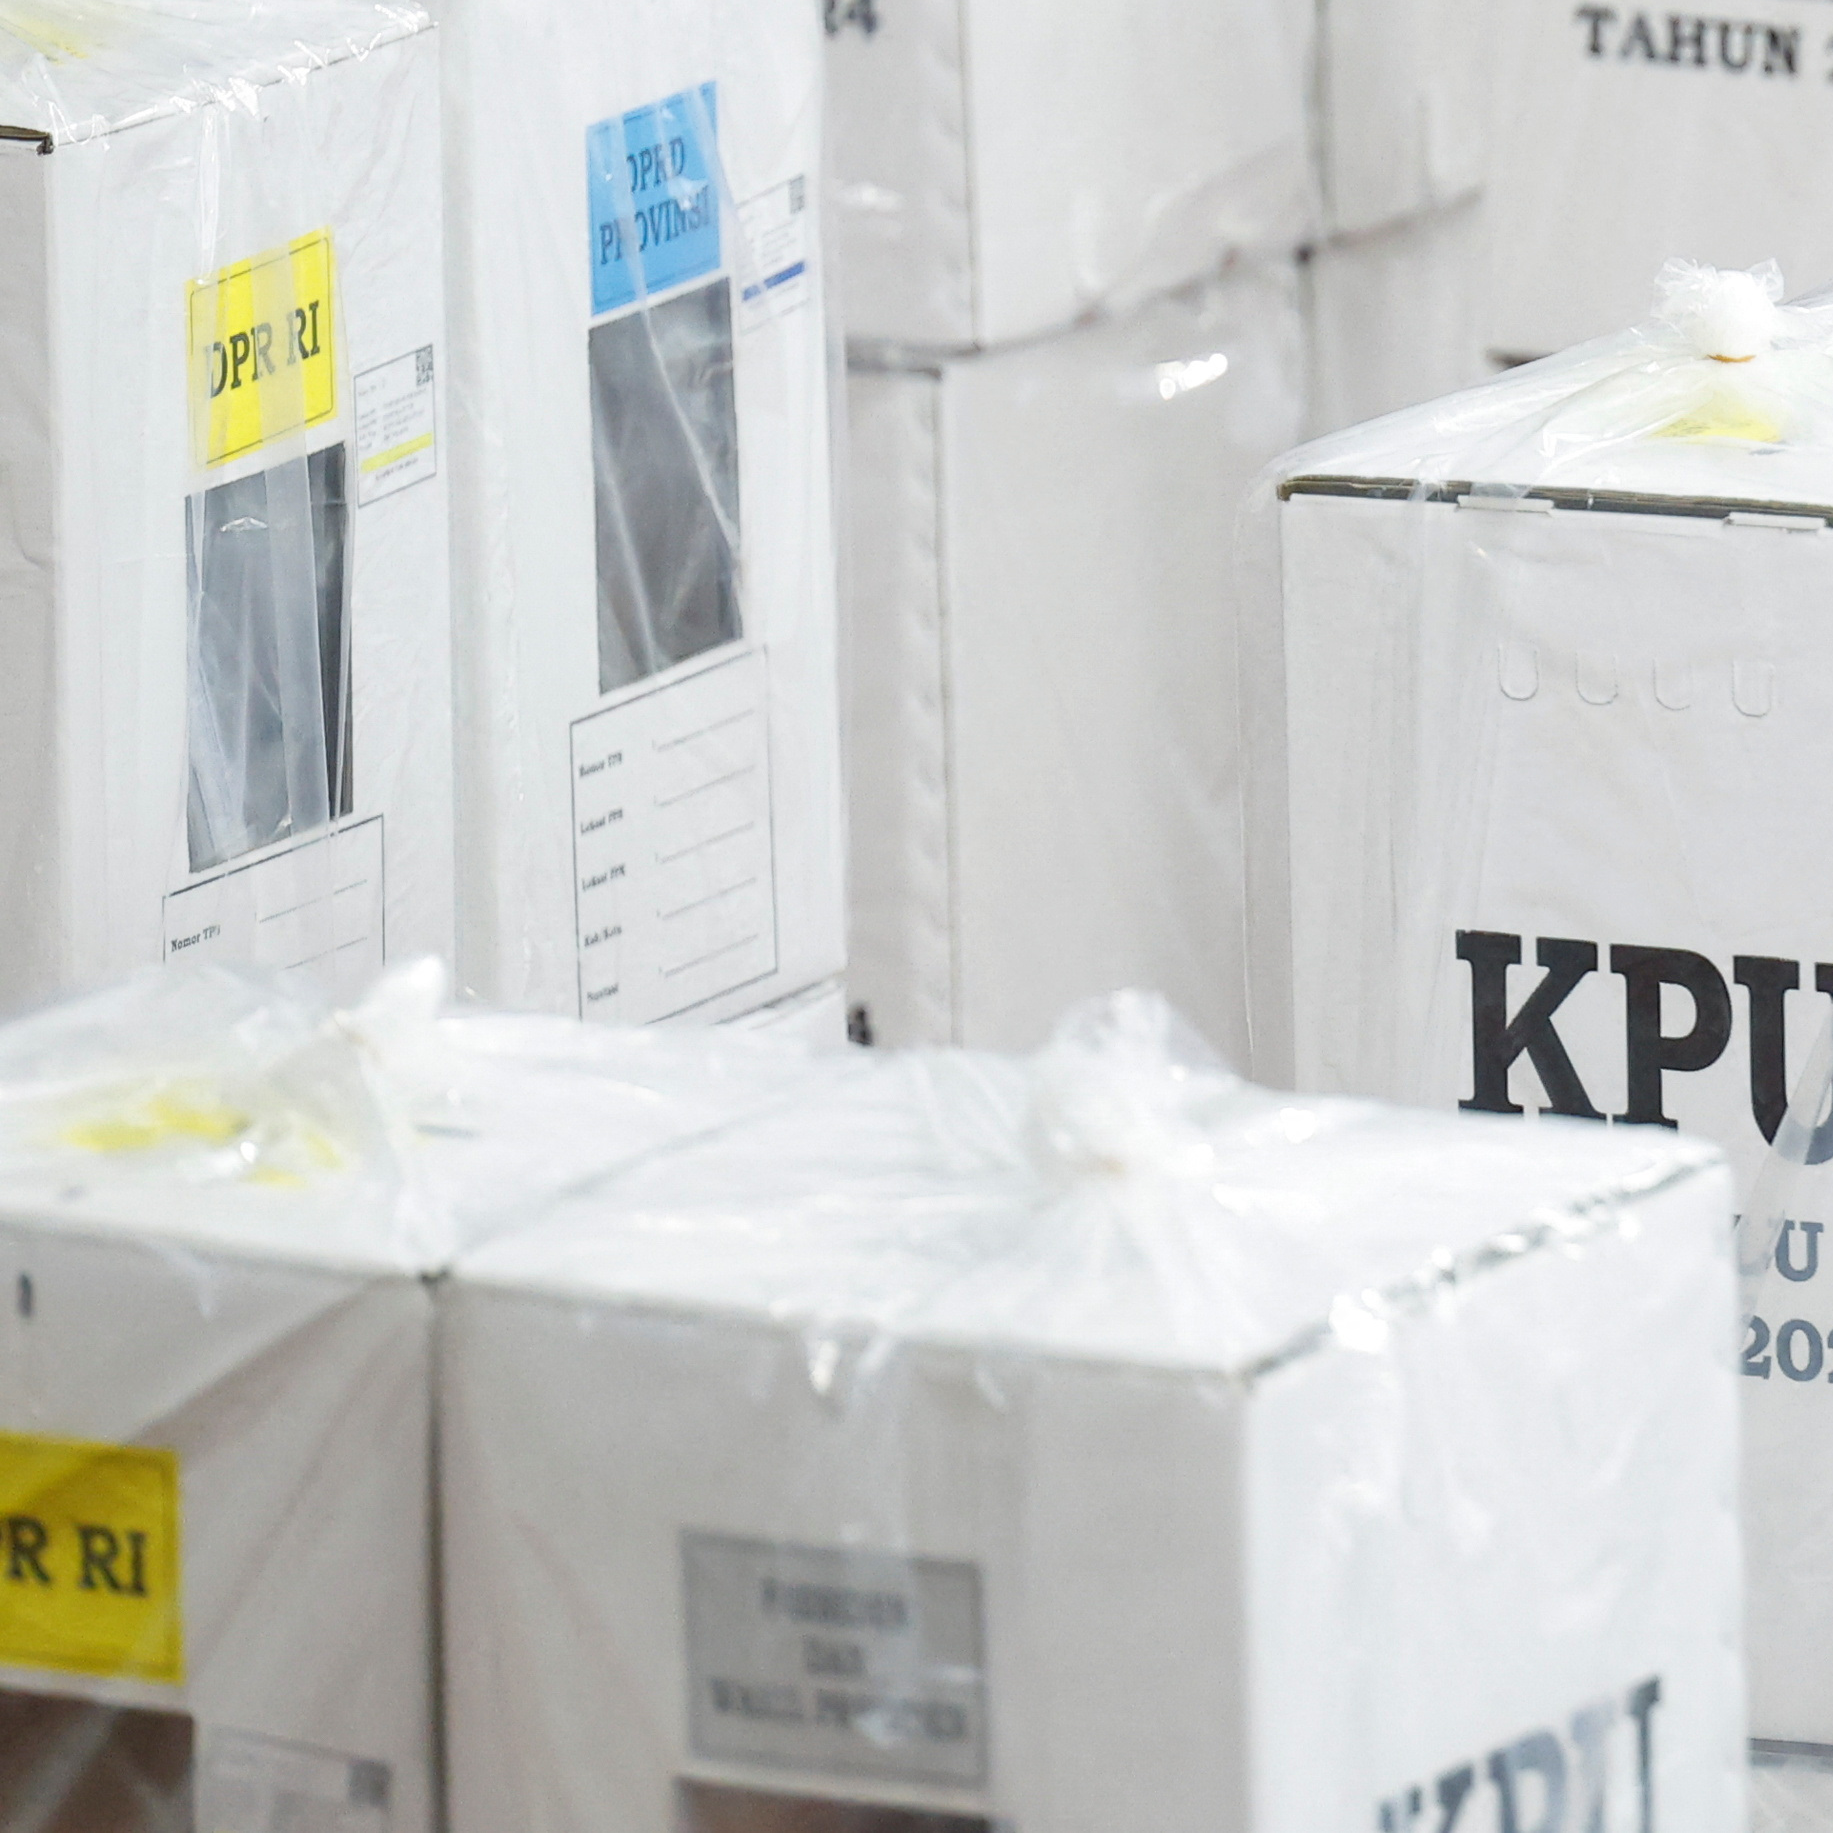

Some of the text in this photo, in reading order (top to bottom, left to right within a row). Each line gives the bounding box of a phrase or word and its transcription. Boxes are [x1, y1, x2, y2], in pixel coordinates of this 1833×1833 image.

[1576, 7, 1802, 78] TAHUN
[204, 300, 320, 399] DPR RI
[171, 925, 221, 952] Nomor TP
[77, 1523, 149, 1596] RI
